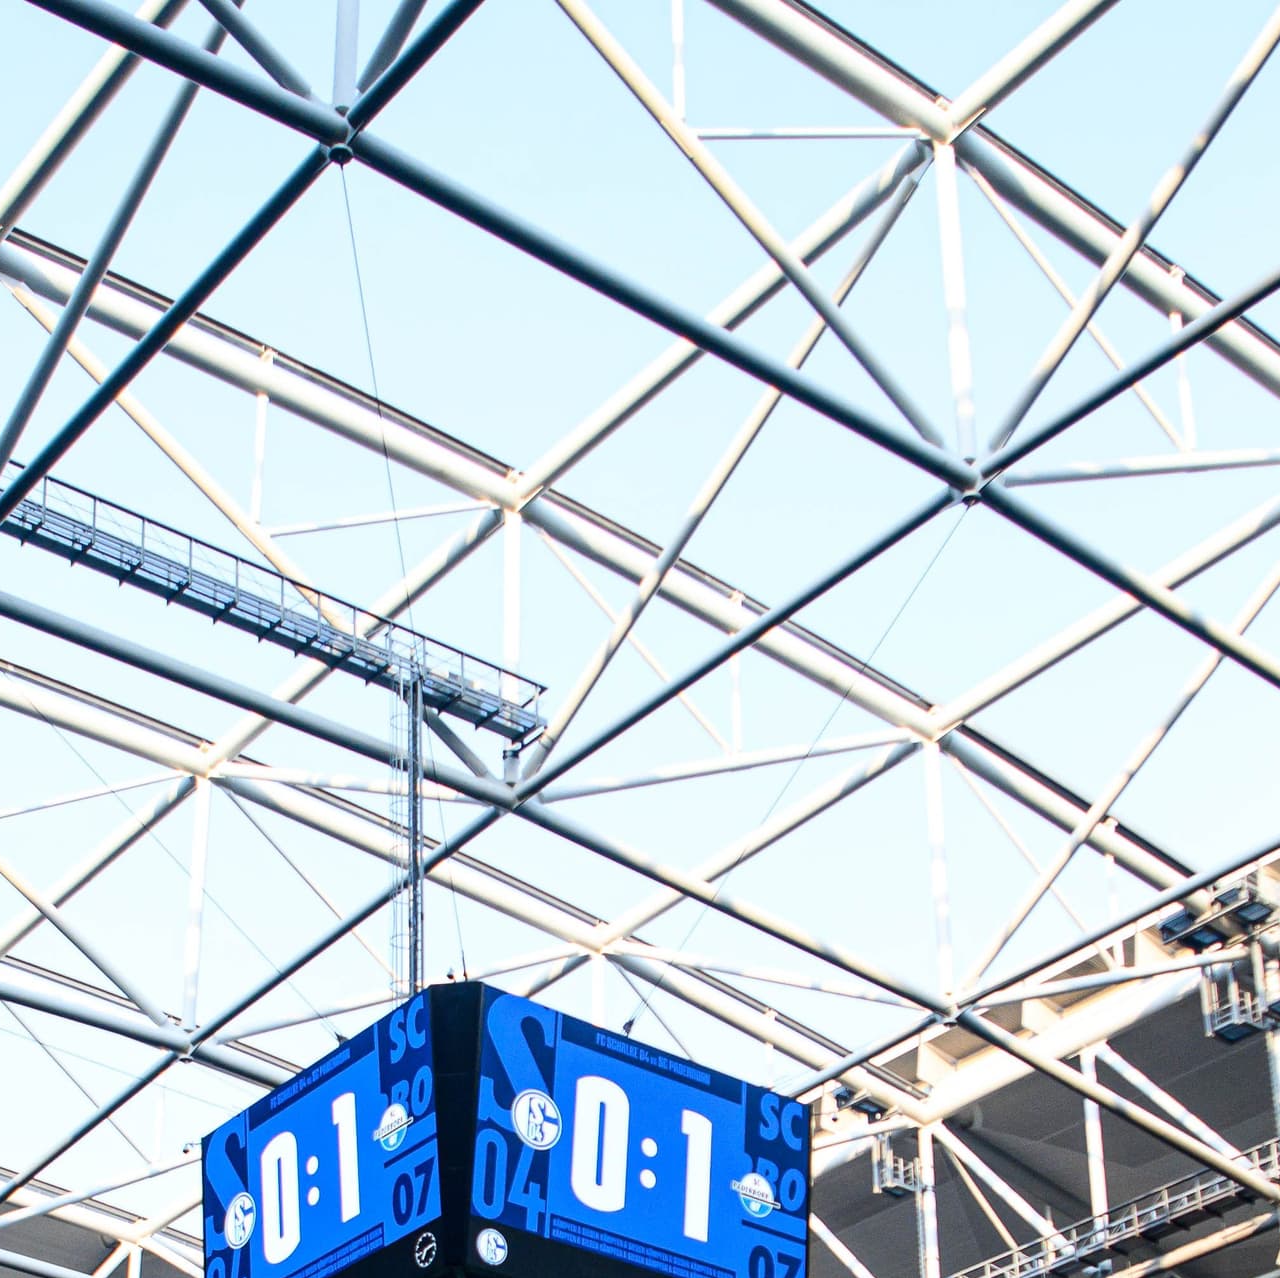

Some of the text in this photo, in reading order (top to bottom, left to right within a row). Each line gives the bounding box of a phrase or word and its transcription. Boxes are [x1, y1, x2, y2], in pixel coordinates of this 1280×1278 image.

[389, 996, 426, 1064] SC
[759, 1092, 803, 1151] SC
[392, 1156, 435, 1226] 07
